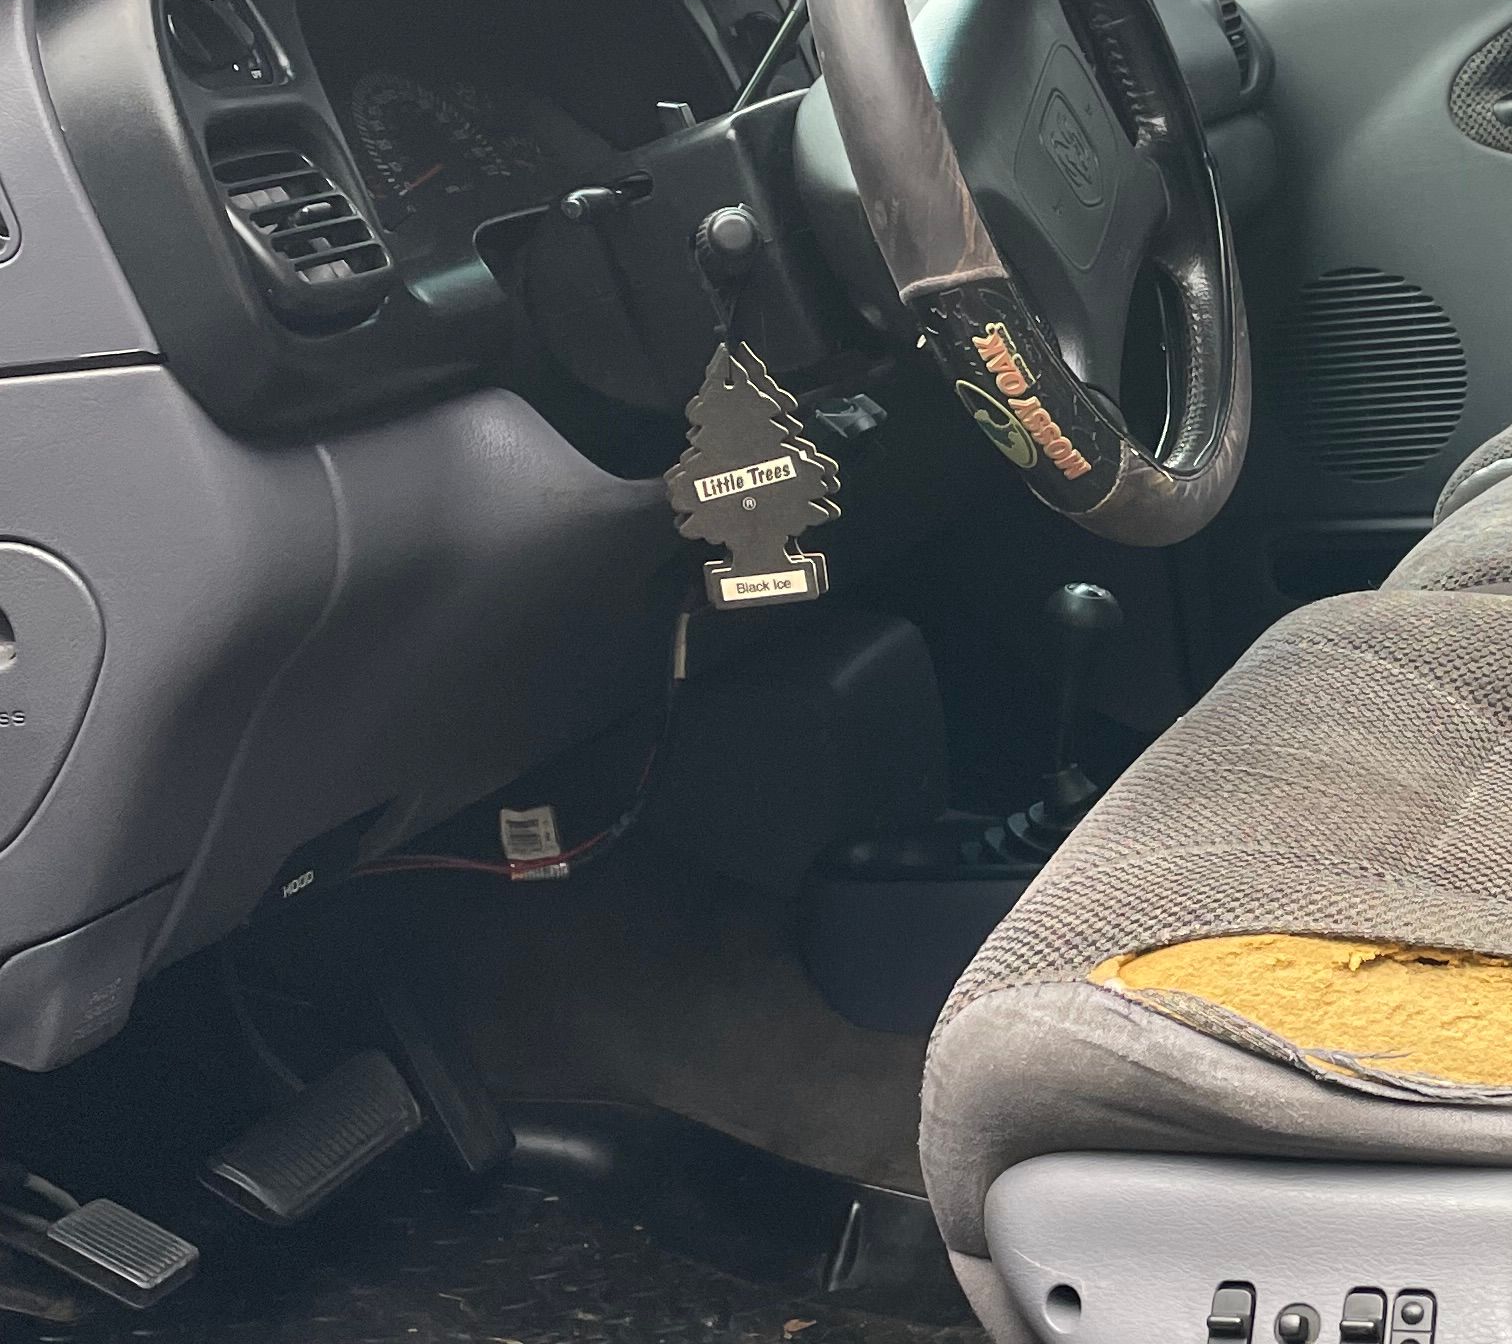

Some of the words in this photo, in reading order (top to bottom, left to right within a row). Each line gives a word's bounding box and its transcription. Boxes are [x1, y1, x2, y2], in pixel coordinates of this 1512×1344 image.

[972, 331, 1029, 396] OAK
[1008, 396, 1091, 480] MOSSY
[702, 473, 744, 498] Little
[746, 463, 791, 485] Trees
[736, 581, 770, 594] Black
[773, 578, 792, 590] Ice
[283, 870, 314, 898] HOOD
